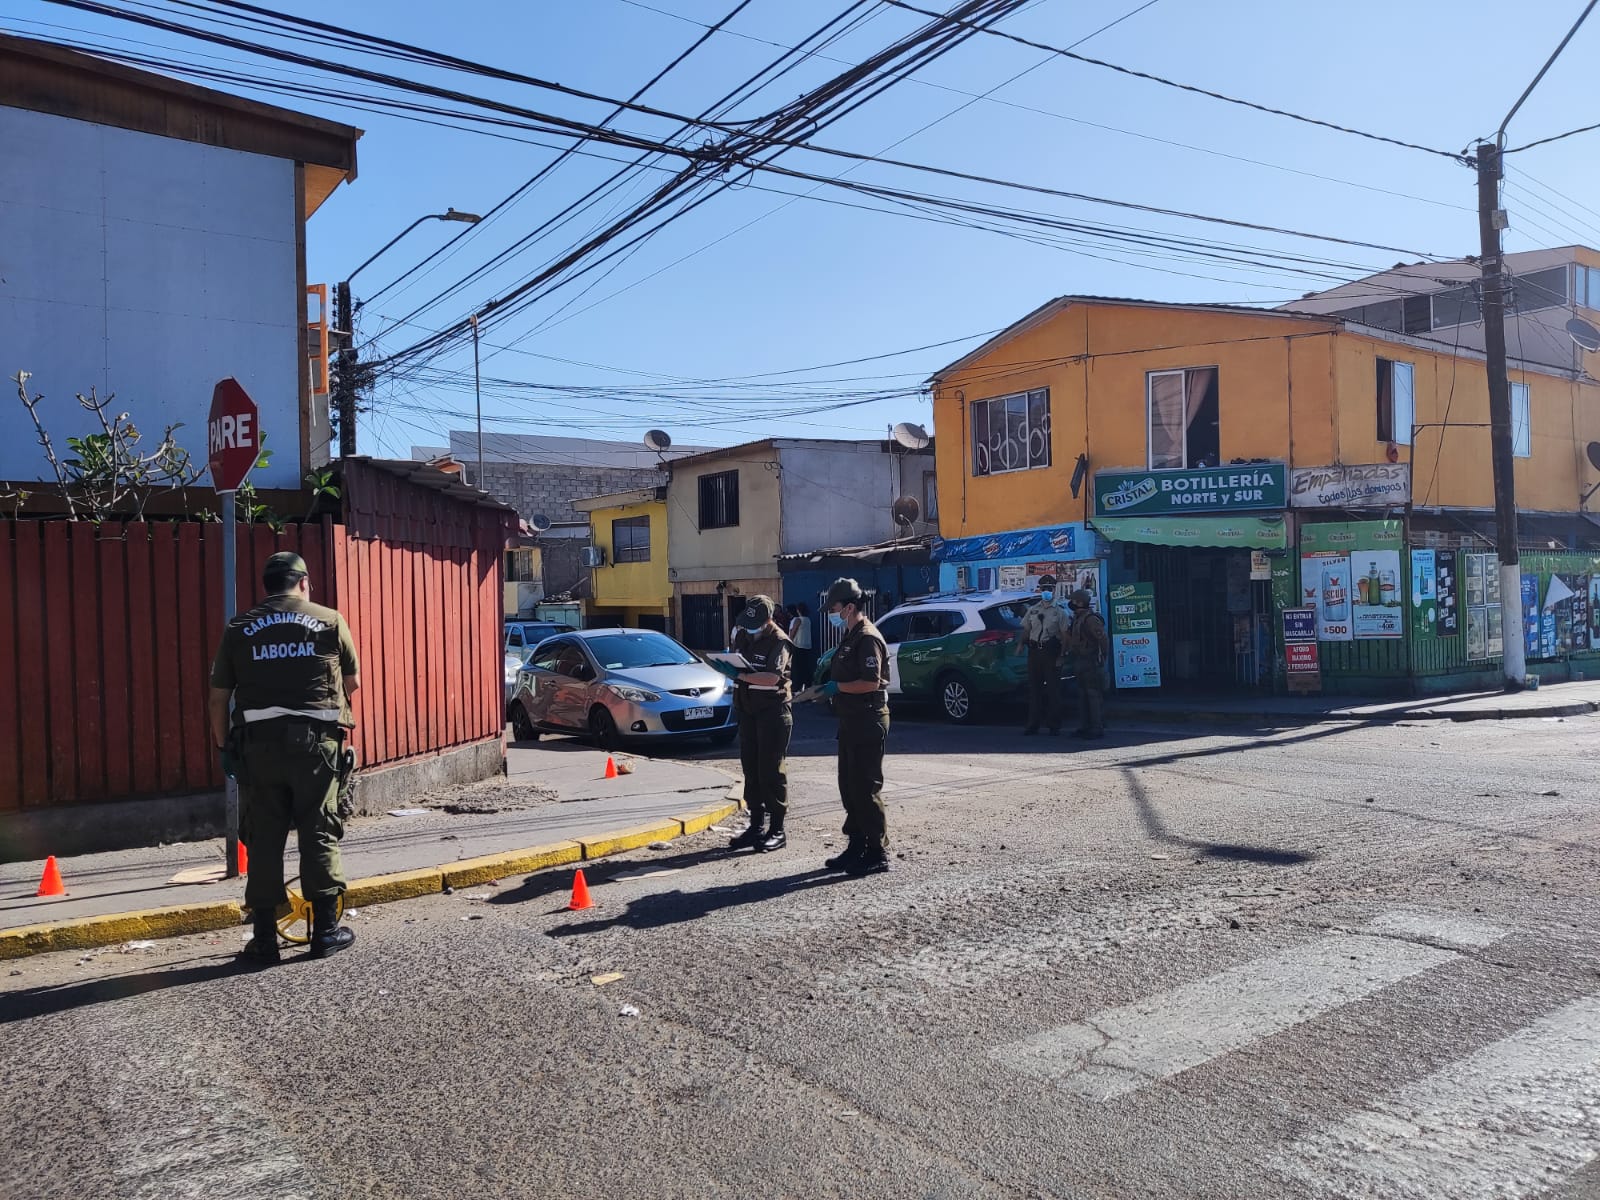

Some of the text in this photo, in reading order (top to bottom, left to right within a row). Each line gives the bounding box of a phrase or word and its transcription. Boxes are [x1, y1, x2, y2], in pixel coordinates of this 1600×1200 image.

[210, 414, 252, 455] PARE
[1161, 470, 1274, 491] BOTILLERÍA
[1107, 481, 1154, 507] CRISTAL
[1171, 489, 1263, 505] NORTE y SUR
[1317, 491, 1346, 504] todos
[1346, 487, 1362, 499] los
[1322, 558, 1346, 566] SILVER
[243, 612, 325, 637] CARABINEROS
[1324, 626, 1347, 634] $500
[1121, 637, 1150, 646] Escudo
[252, 642, 316, 660] LABOCAR
